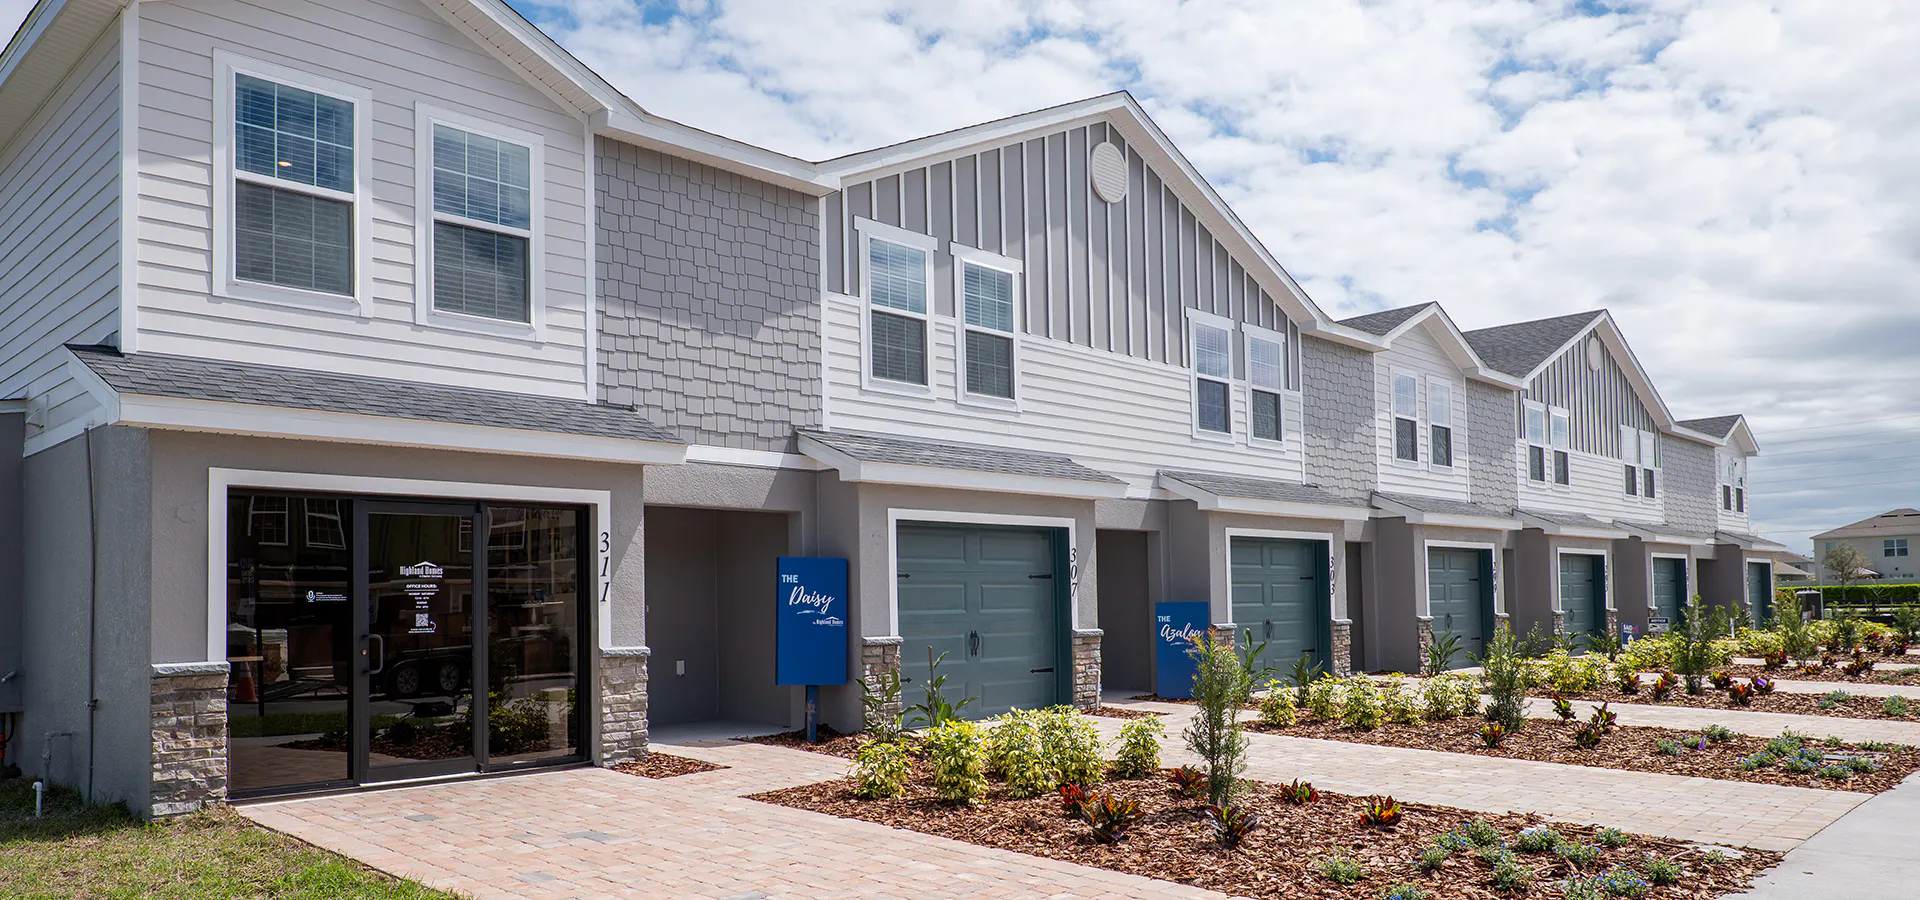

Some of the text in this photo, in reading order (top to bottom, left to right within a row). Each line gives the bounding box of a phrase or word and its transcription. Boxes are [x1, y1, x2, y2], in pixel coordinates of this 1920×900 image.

[400, 566, 443, 576] Highland Homes
[600, 531, 610, 602] 311
[781, 574, 799, 583] THE
[1070, 548, 1078, 597] 307
[789, 585, 835, 613] Daisy
[1160, 622, 1203, 642] Azalea
